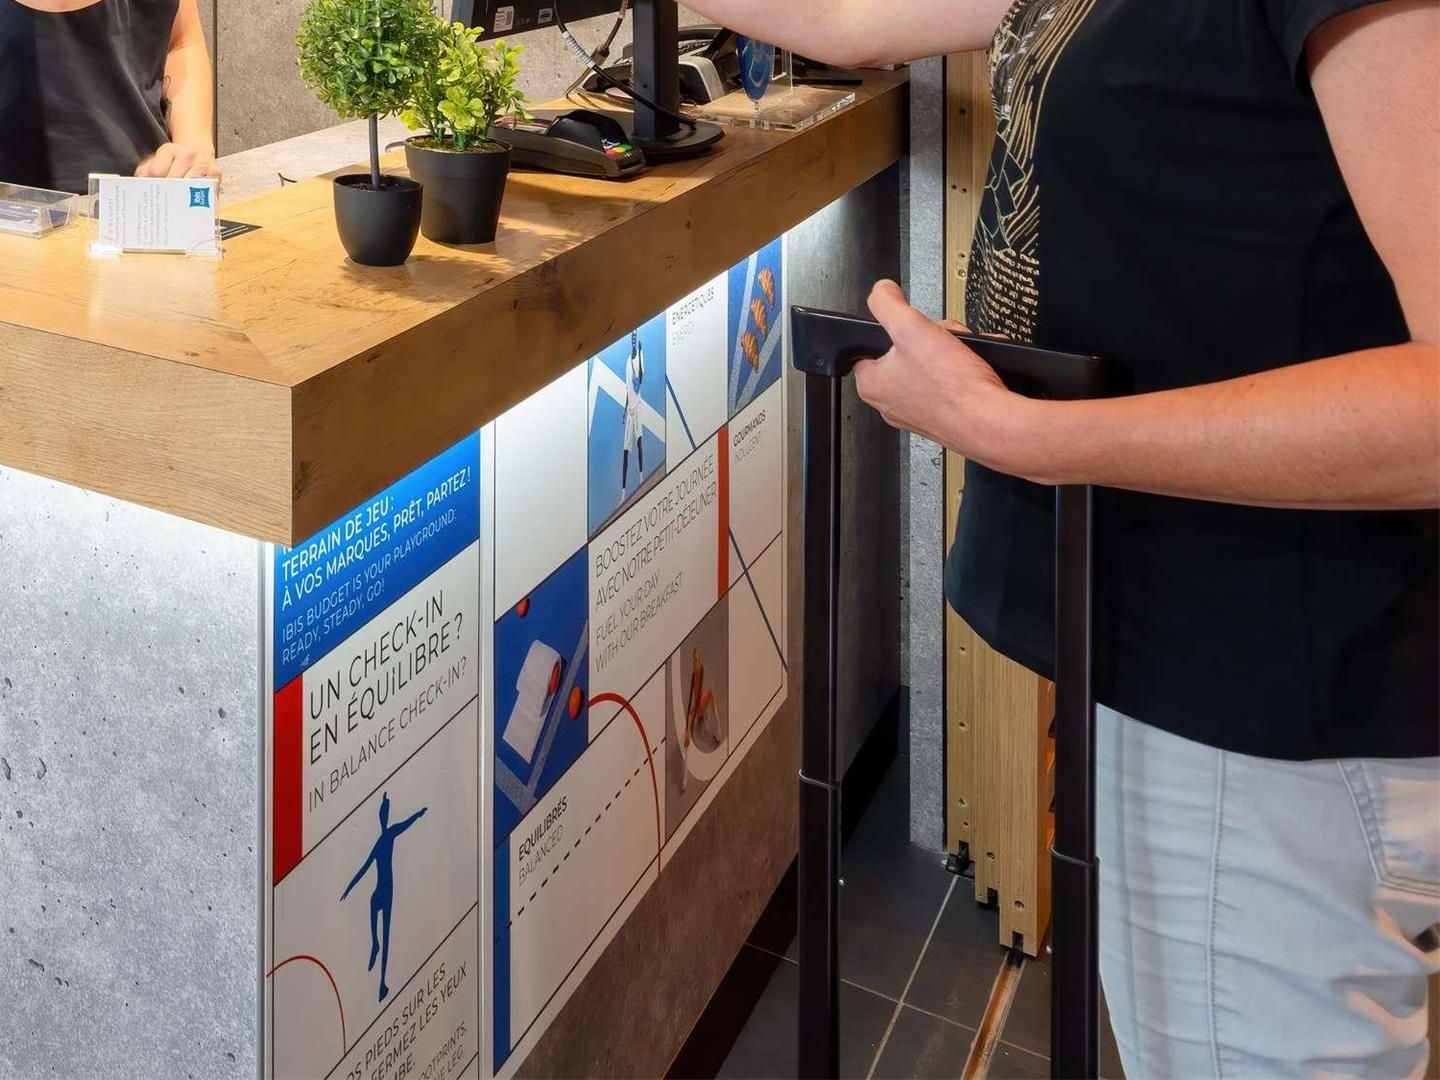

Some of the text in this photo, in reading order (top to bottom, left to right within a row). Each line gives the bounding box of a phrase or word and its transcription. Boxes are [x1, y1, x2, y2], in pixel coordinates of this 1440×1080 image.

[282, 530, 340, 582] TERRAIN
[345, 513, 362, 541] DE
[282, 586, 292, 612] À
[295, 569, 323, 600] VOS
[326, 523, 390, 580] MARQUES,
[393, 497, 424, 533] PRÊT,
[596, 454, 714, 578] BOOSTEZ VOTRE JOURNÉE
[282, 508, 456, 643] IBIS BUDGET IS YOUR PLAYGROUND:
[282, 578, 385, 666] READY, STEADY, GO!
[595, 572, 683, 672] WITH OUR BREAKFAST
[596, 571, 621, 611] AVEC
[622, 549, 652, 589] NOTRE
[596, 568, 660, 647] FUEL YOUR DAY
[311, 589, 444, 720] UN CHECK-IN
[309, 656, 467, 813] IN BALANCE CHECK-IN?
[310, 714, 338, 765] EN
[365, 1018, 399, 1070] PIEDS
[402, 989, 424, 1025] SUR
[427, 962, 446, 996] LES
[420, 997, 438, 1032] LES
[441, 961, 467, 1004] YEUX
